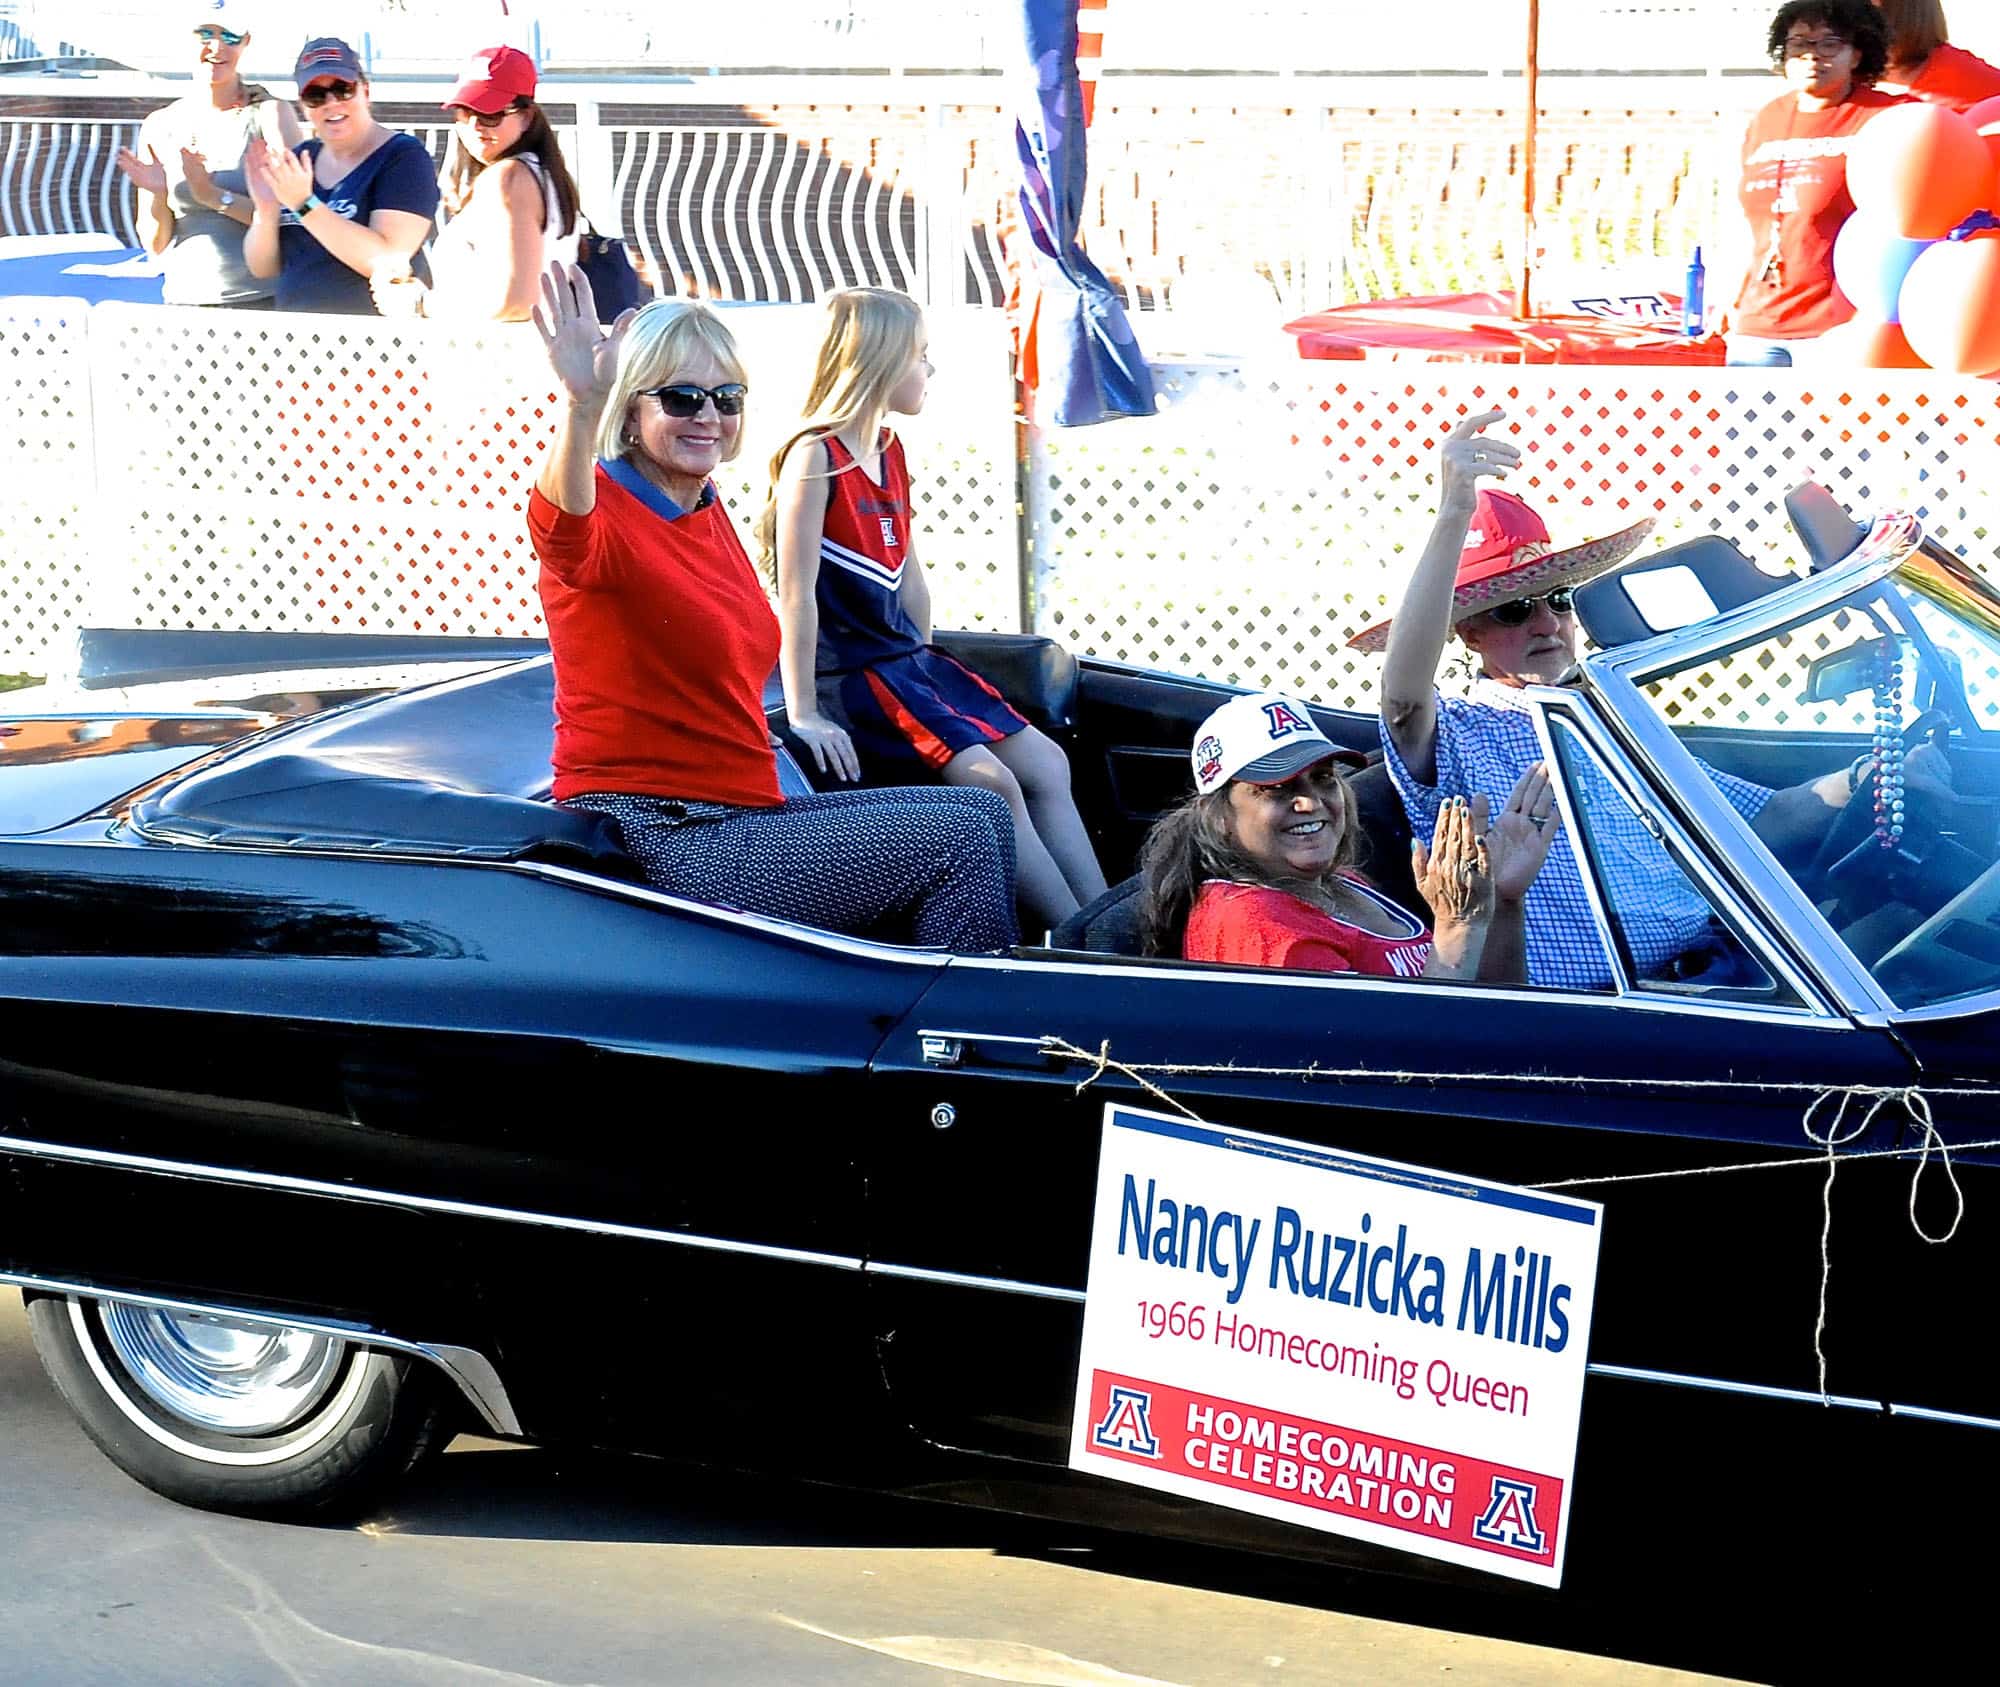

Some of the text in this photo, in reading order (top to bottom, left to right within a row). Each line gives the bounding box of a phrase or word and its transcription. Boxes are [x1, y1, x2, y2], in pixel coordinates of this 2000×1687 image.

[1261, 701, 1312, 740] A
[1118, 1173, 1572, 1354] Nancy Ruzicka Mills
[1137, 1300, 1530, 1417] 1966 Homecoming Queen
[1092, 1384, 1160, 1459] A
[1186, 1402, 1456, 1494] HOMECOMING
[1183, 1437, 1453, 1529] CELEBRATION
[1472, 1475, 1546, 1554] A
